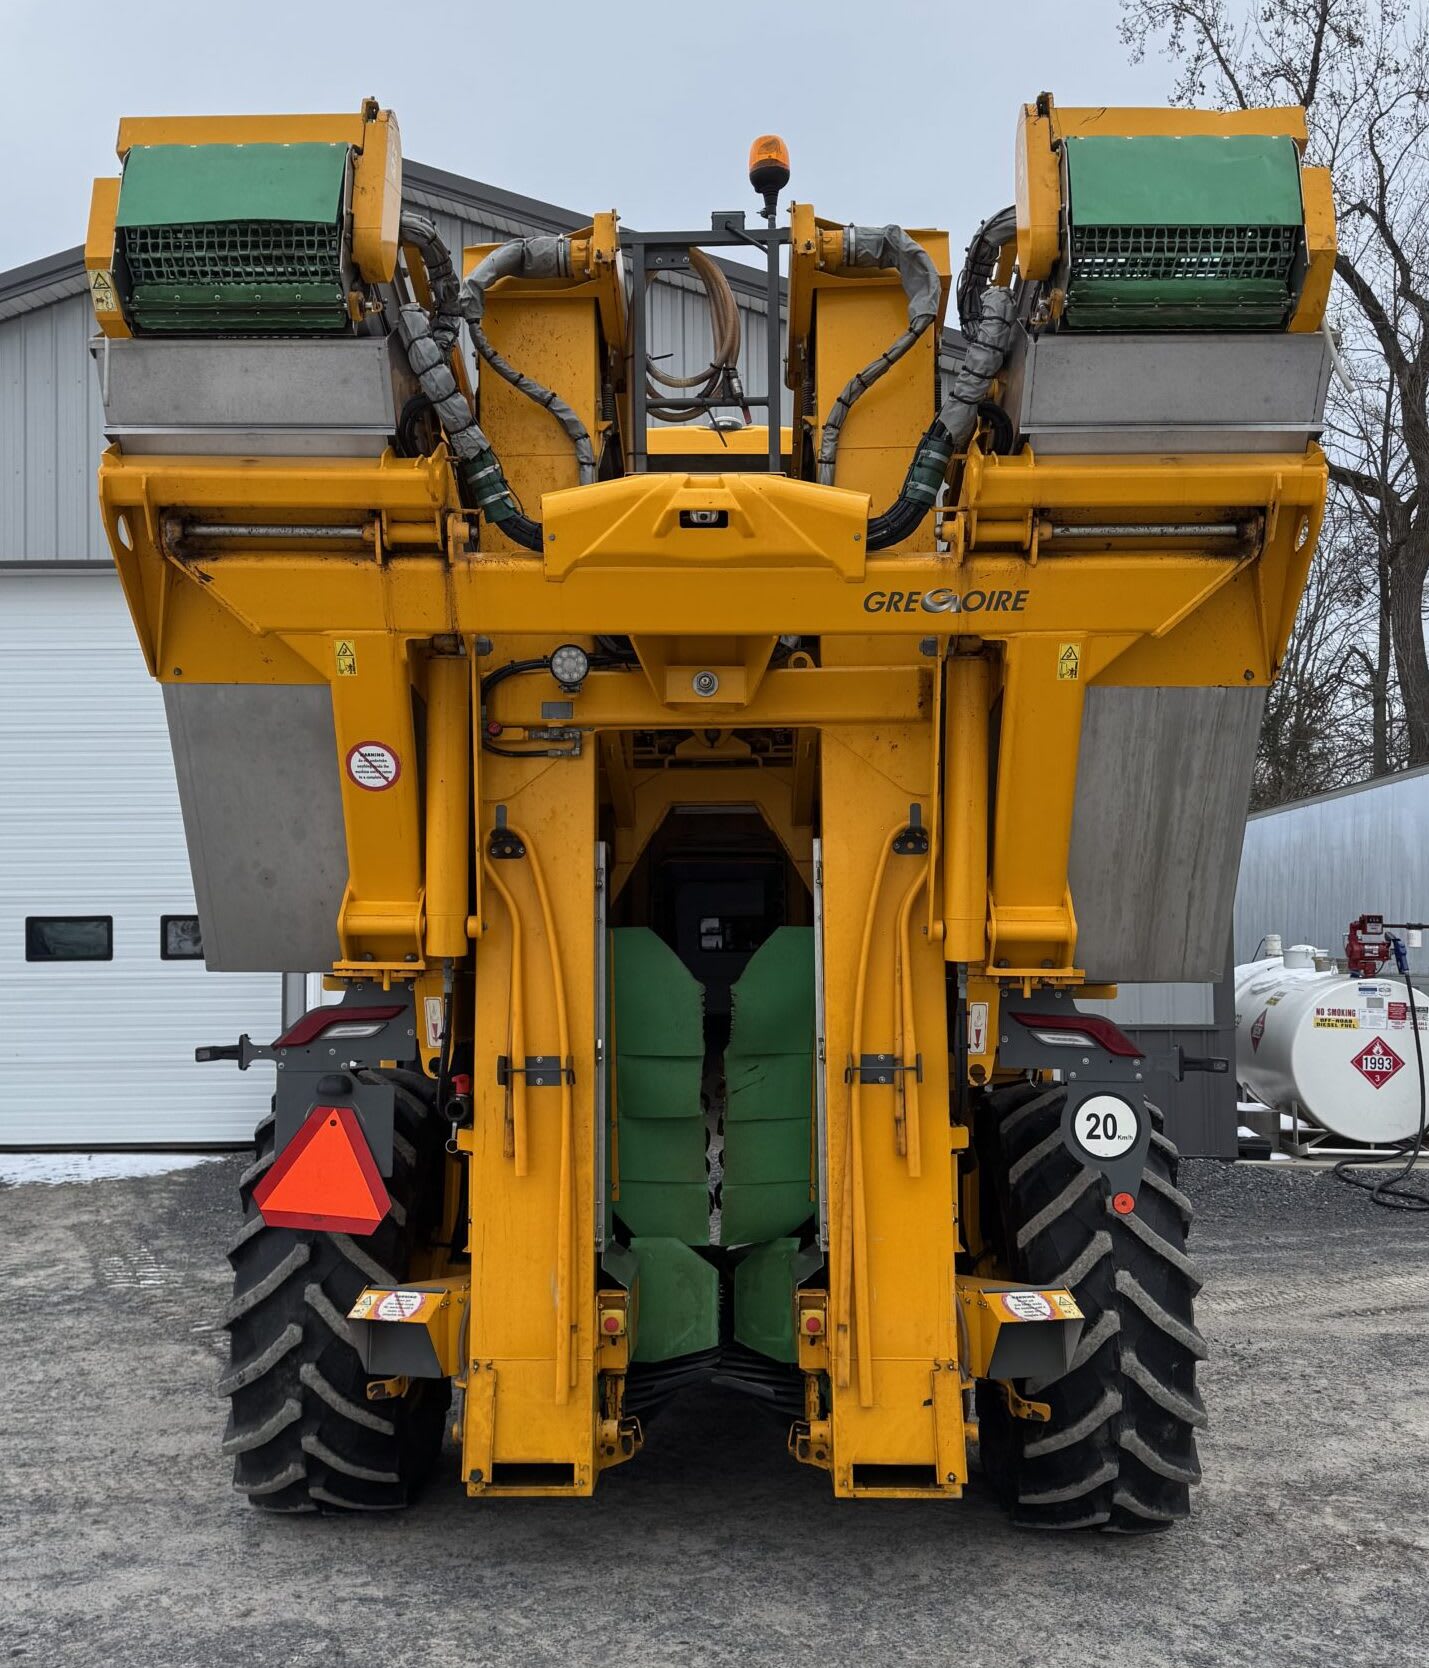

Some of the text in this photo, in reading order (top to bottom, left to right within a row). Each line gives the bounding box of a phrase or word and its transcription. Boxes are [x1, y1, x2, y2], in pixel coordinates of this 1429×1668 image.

[863, 588, 1030, 614] GREGOIRE
[1316, 1008, 1356, 1017] NO SMOKING
[1364, 1057, 1392, 1070] 1993
[1086, 1113, 1117, 1140] 20
